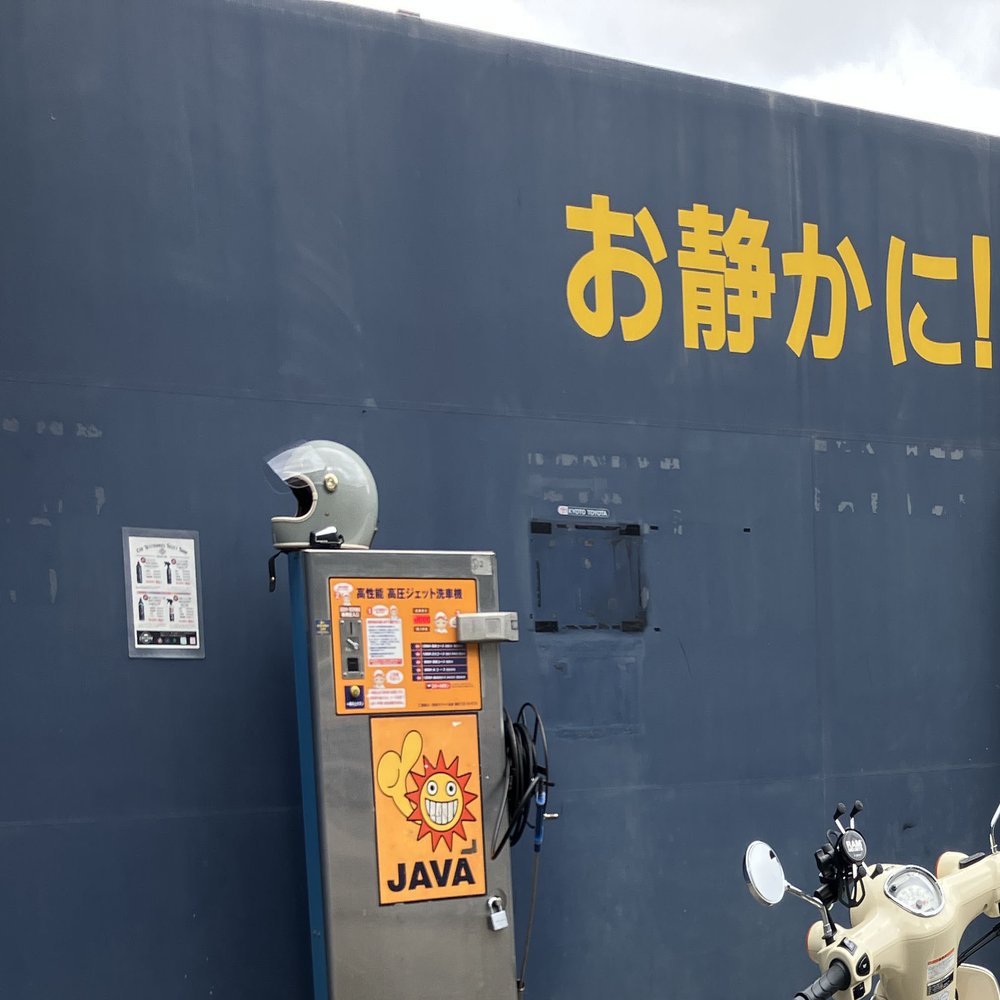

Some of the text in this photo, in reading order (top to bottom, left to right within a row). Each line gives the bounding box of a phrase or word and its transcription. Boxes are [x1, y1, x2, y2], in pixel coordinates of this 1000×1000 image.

[565, 194, 993, 369] お静かに!
[357, 587, 384, 599] 高性能
[387, 587, 463, 600] 高圧ジェット洗車機
[387, 857, 476, 892] JAVA
